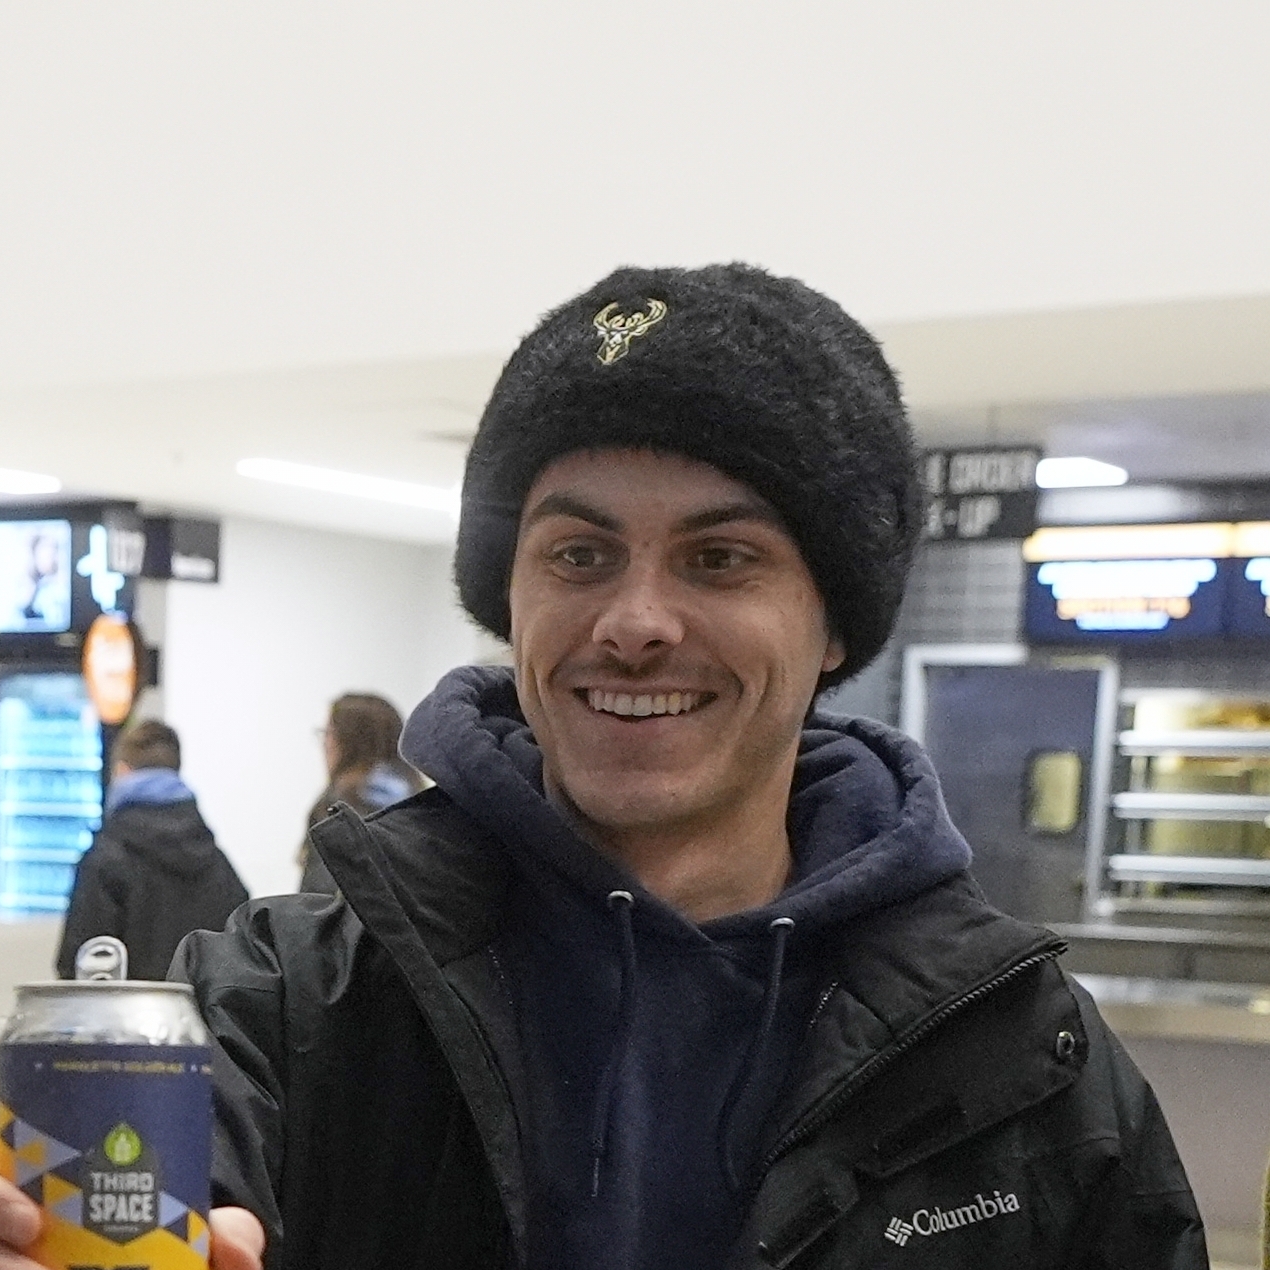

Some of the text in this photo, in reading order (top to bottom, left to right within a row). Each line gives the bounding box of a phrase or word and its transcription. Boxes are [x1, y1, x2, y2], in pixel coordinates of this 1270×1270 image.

[91, 1171, 154, 1191] THIRD
[89, 1193, 154, 1223] SPACE
[913, 1190, 1020, 1236] Columbia
